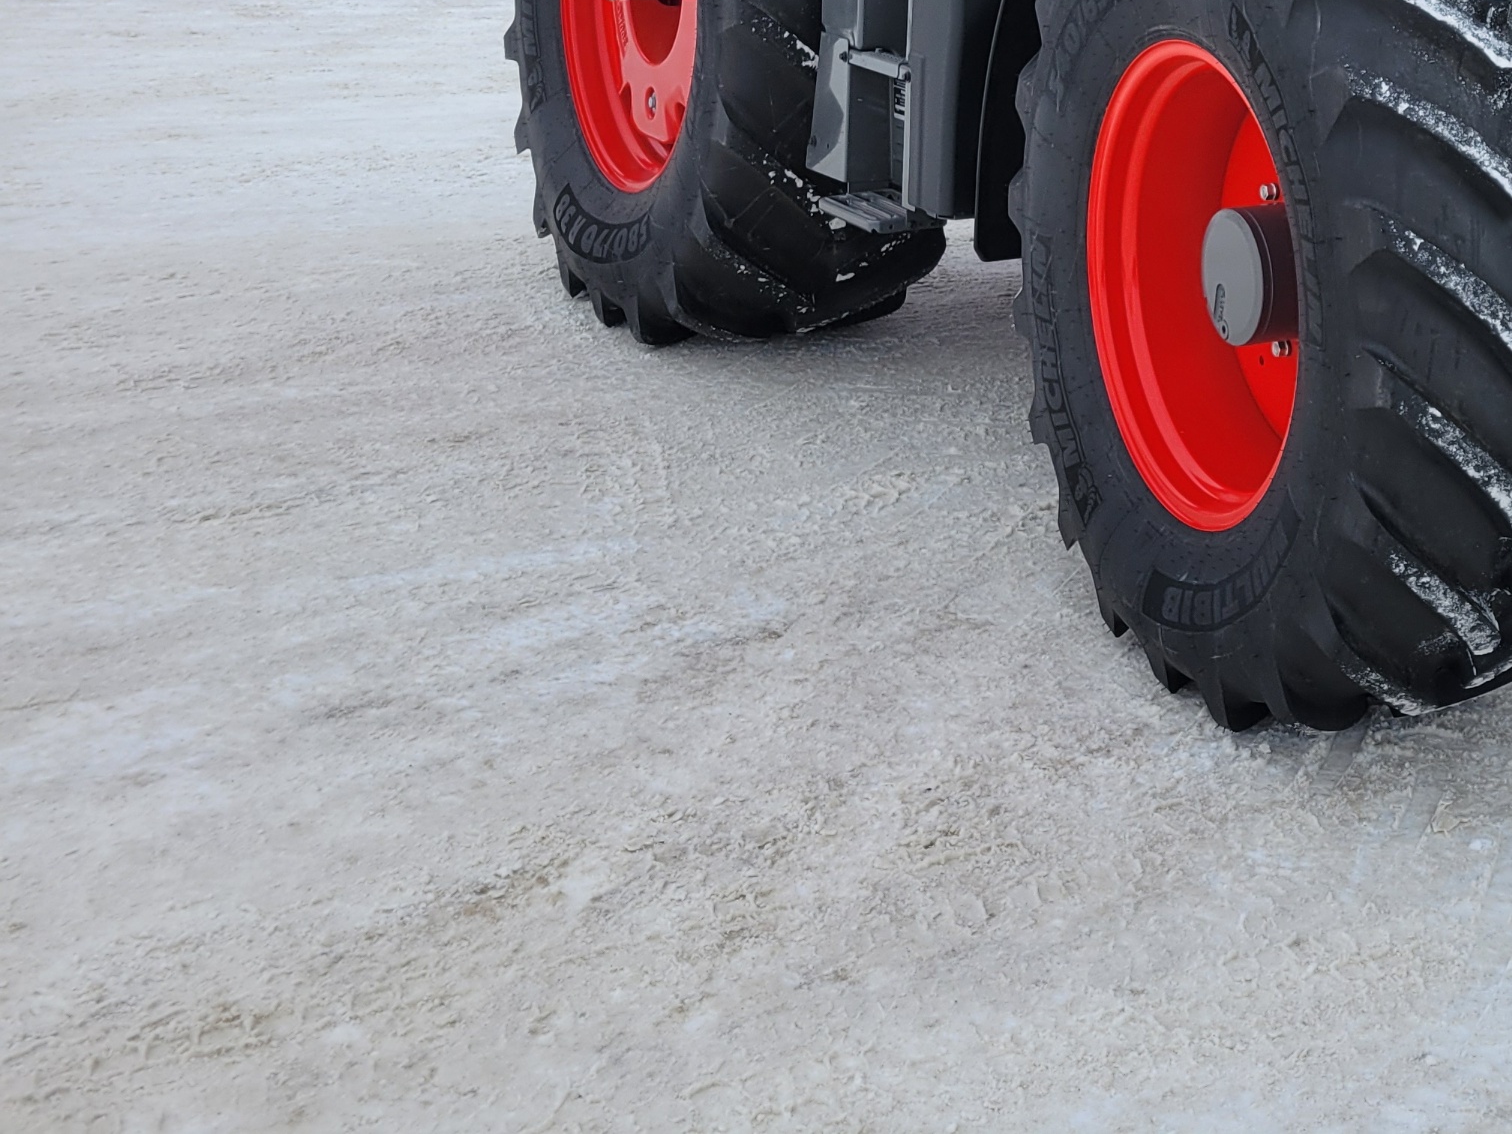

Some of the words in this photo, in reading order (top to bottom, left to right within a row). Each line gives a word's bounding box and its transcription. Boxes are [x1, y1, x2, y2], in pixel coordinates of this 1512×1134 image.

[580, 213, 651, 259] 580/70
[1253, 65, 1323, 343] MICHELIN
[1030, 242, 1081, 467] MICHELIN
[1161, 520, 1289, 625] MULTIBIB
